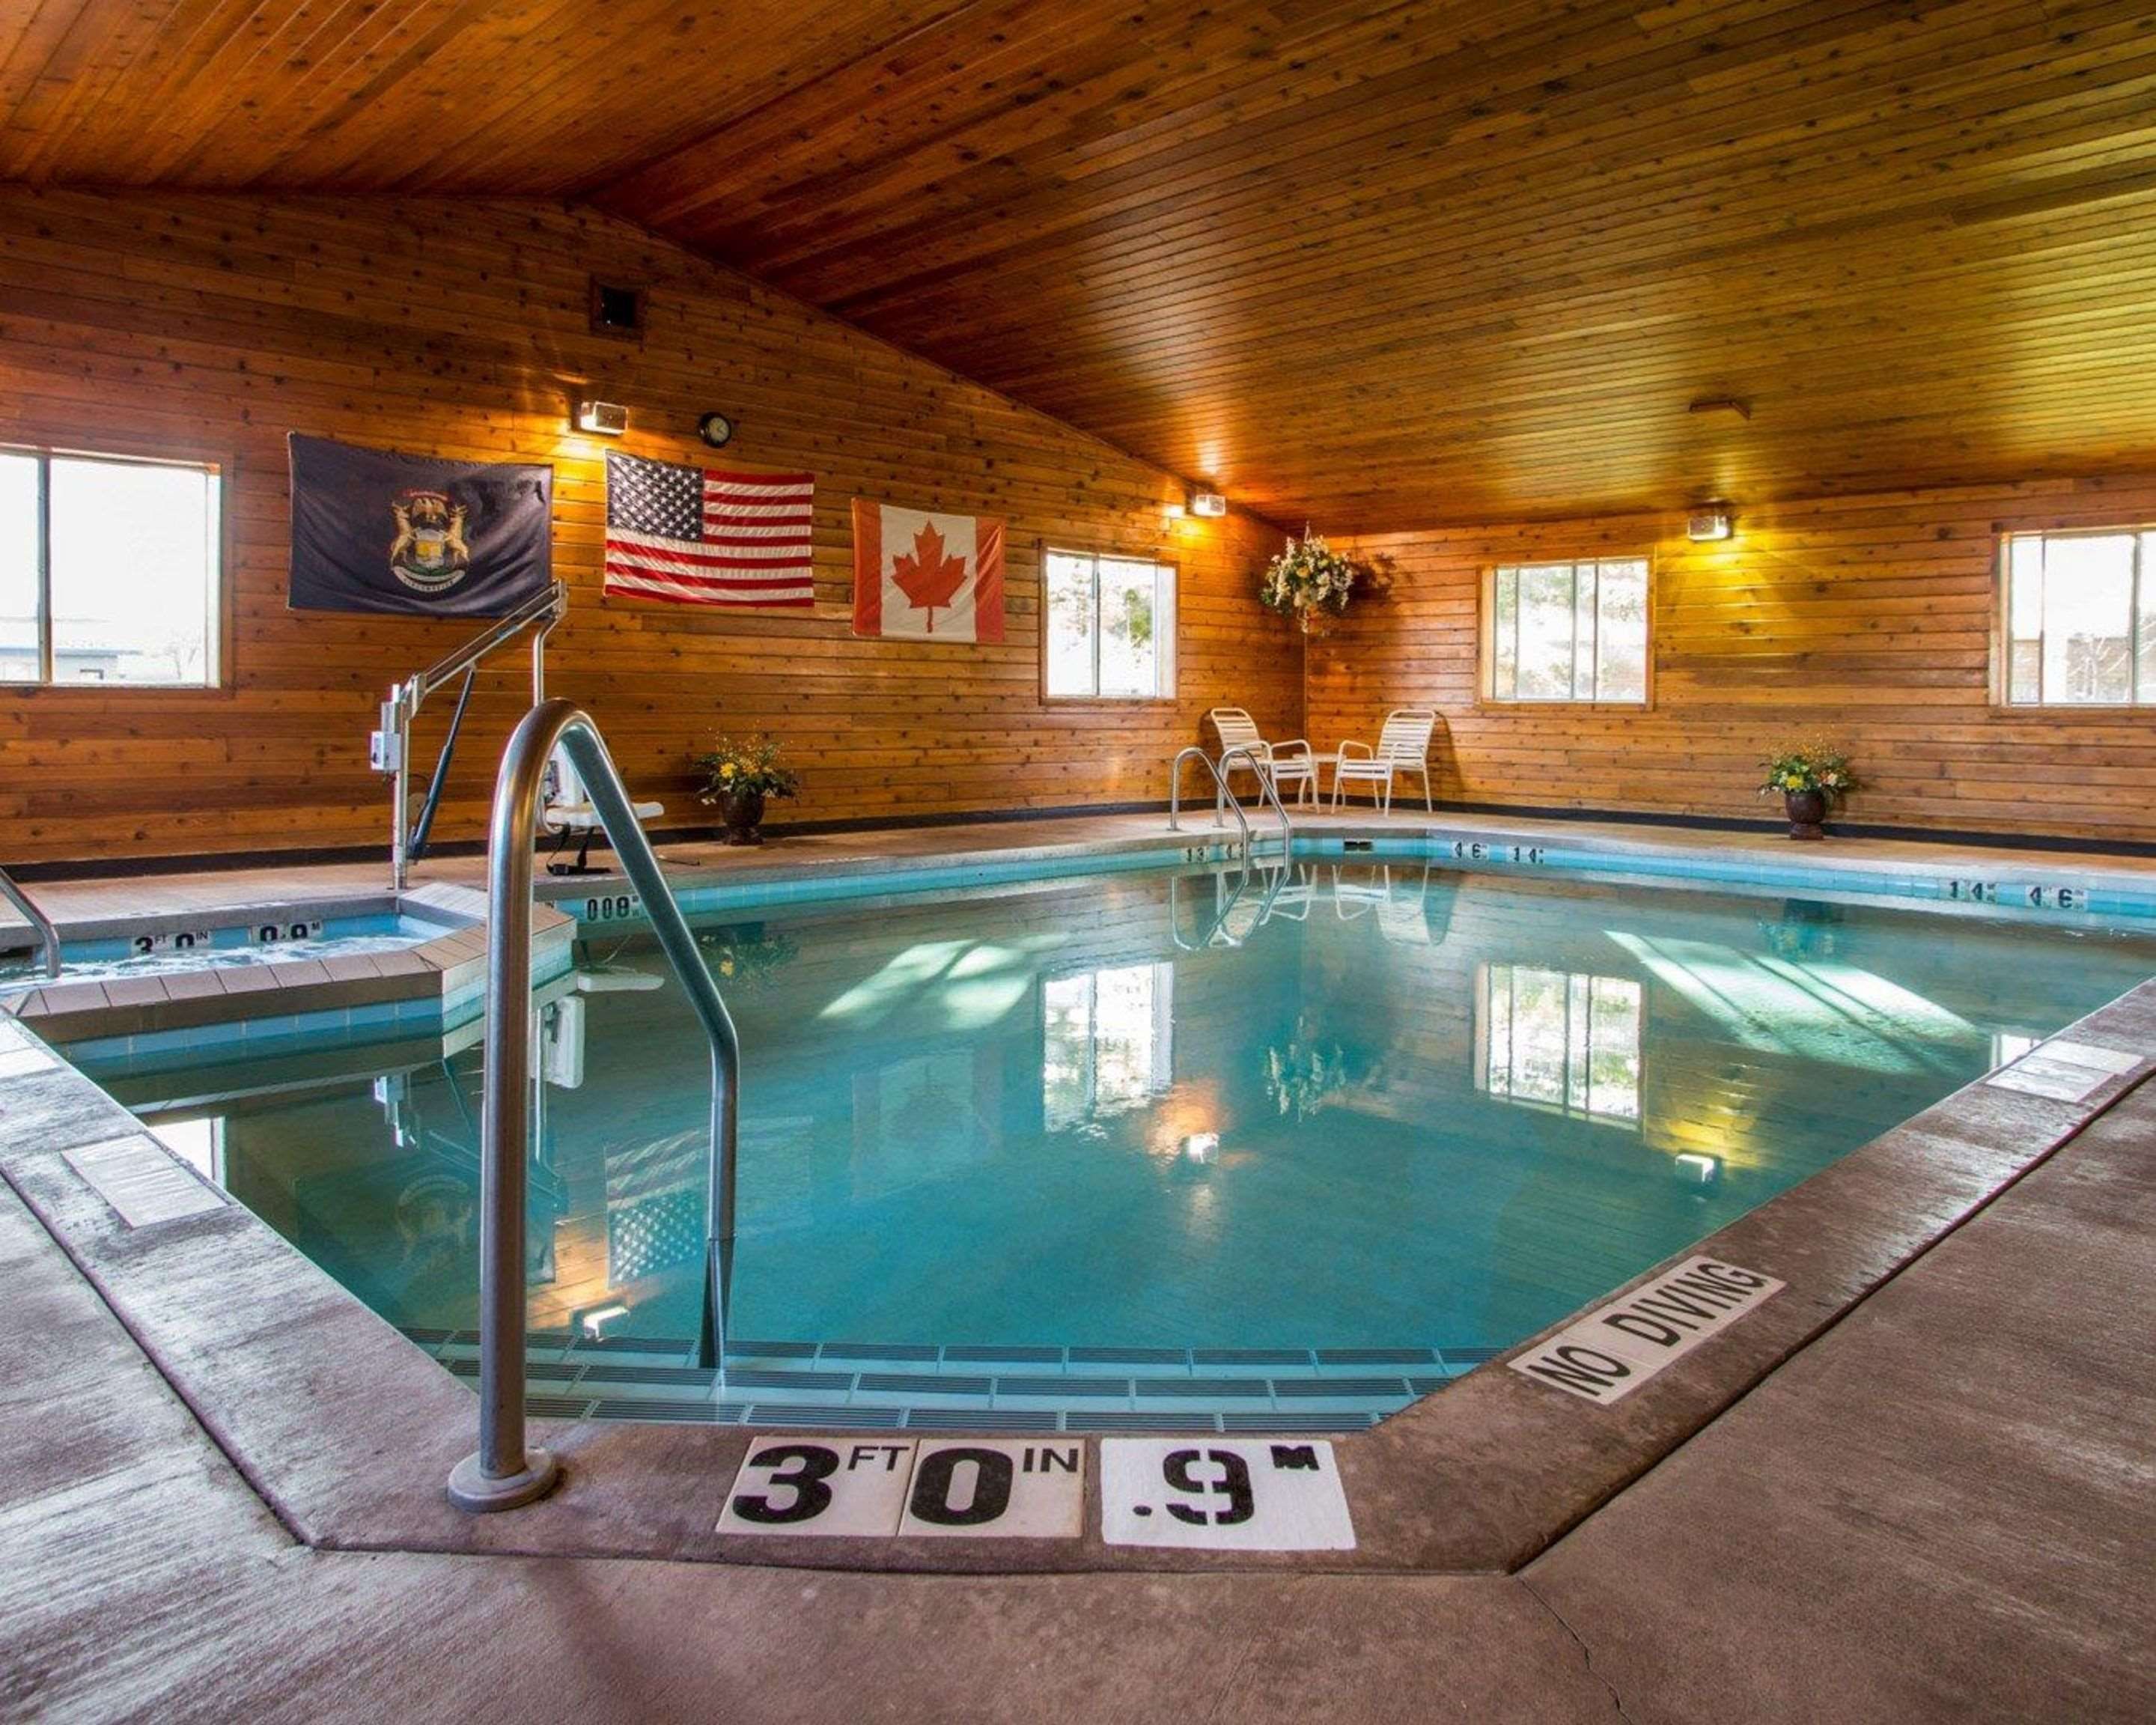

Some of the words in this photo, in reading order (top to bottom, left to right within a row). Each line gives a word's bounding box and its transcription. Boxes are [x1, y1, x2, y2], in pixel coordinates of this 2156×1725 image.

[135, 937, 153, 953] 3
[1526, 1346, 1631, 1396] NO
[1602, 1263, 1766, 1347] DIVING
[1270, 1444, 1321, 1470] M
[733, 1445, 840, 1524] 3
[847, 1446, 910, 1471] FT
[909, 1447, 1014, 1526] 0
[1023, 1447, 1078, 1473] IN
